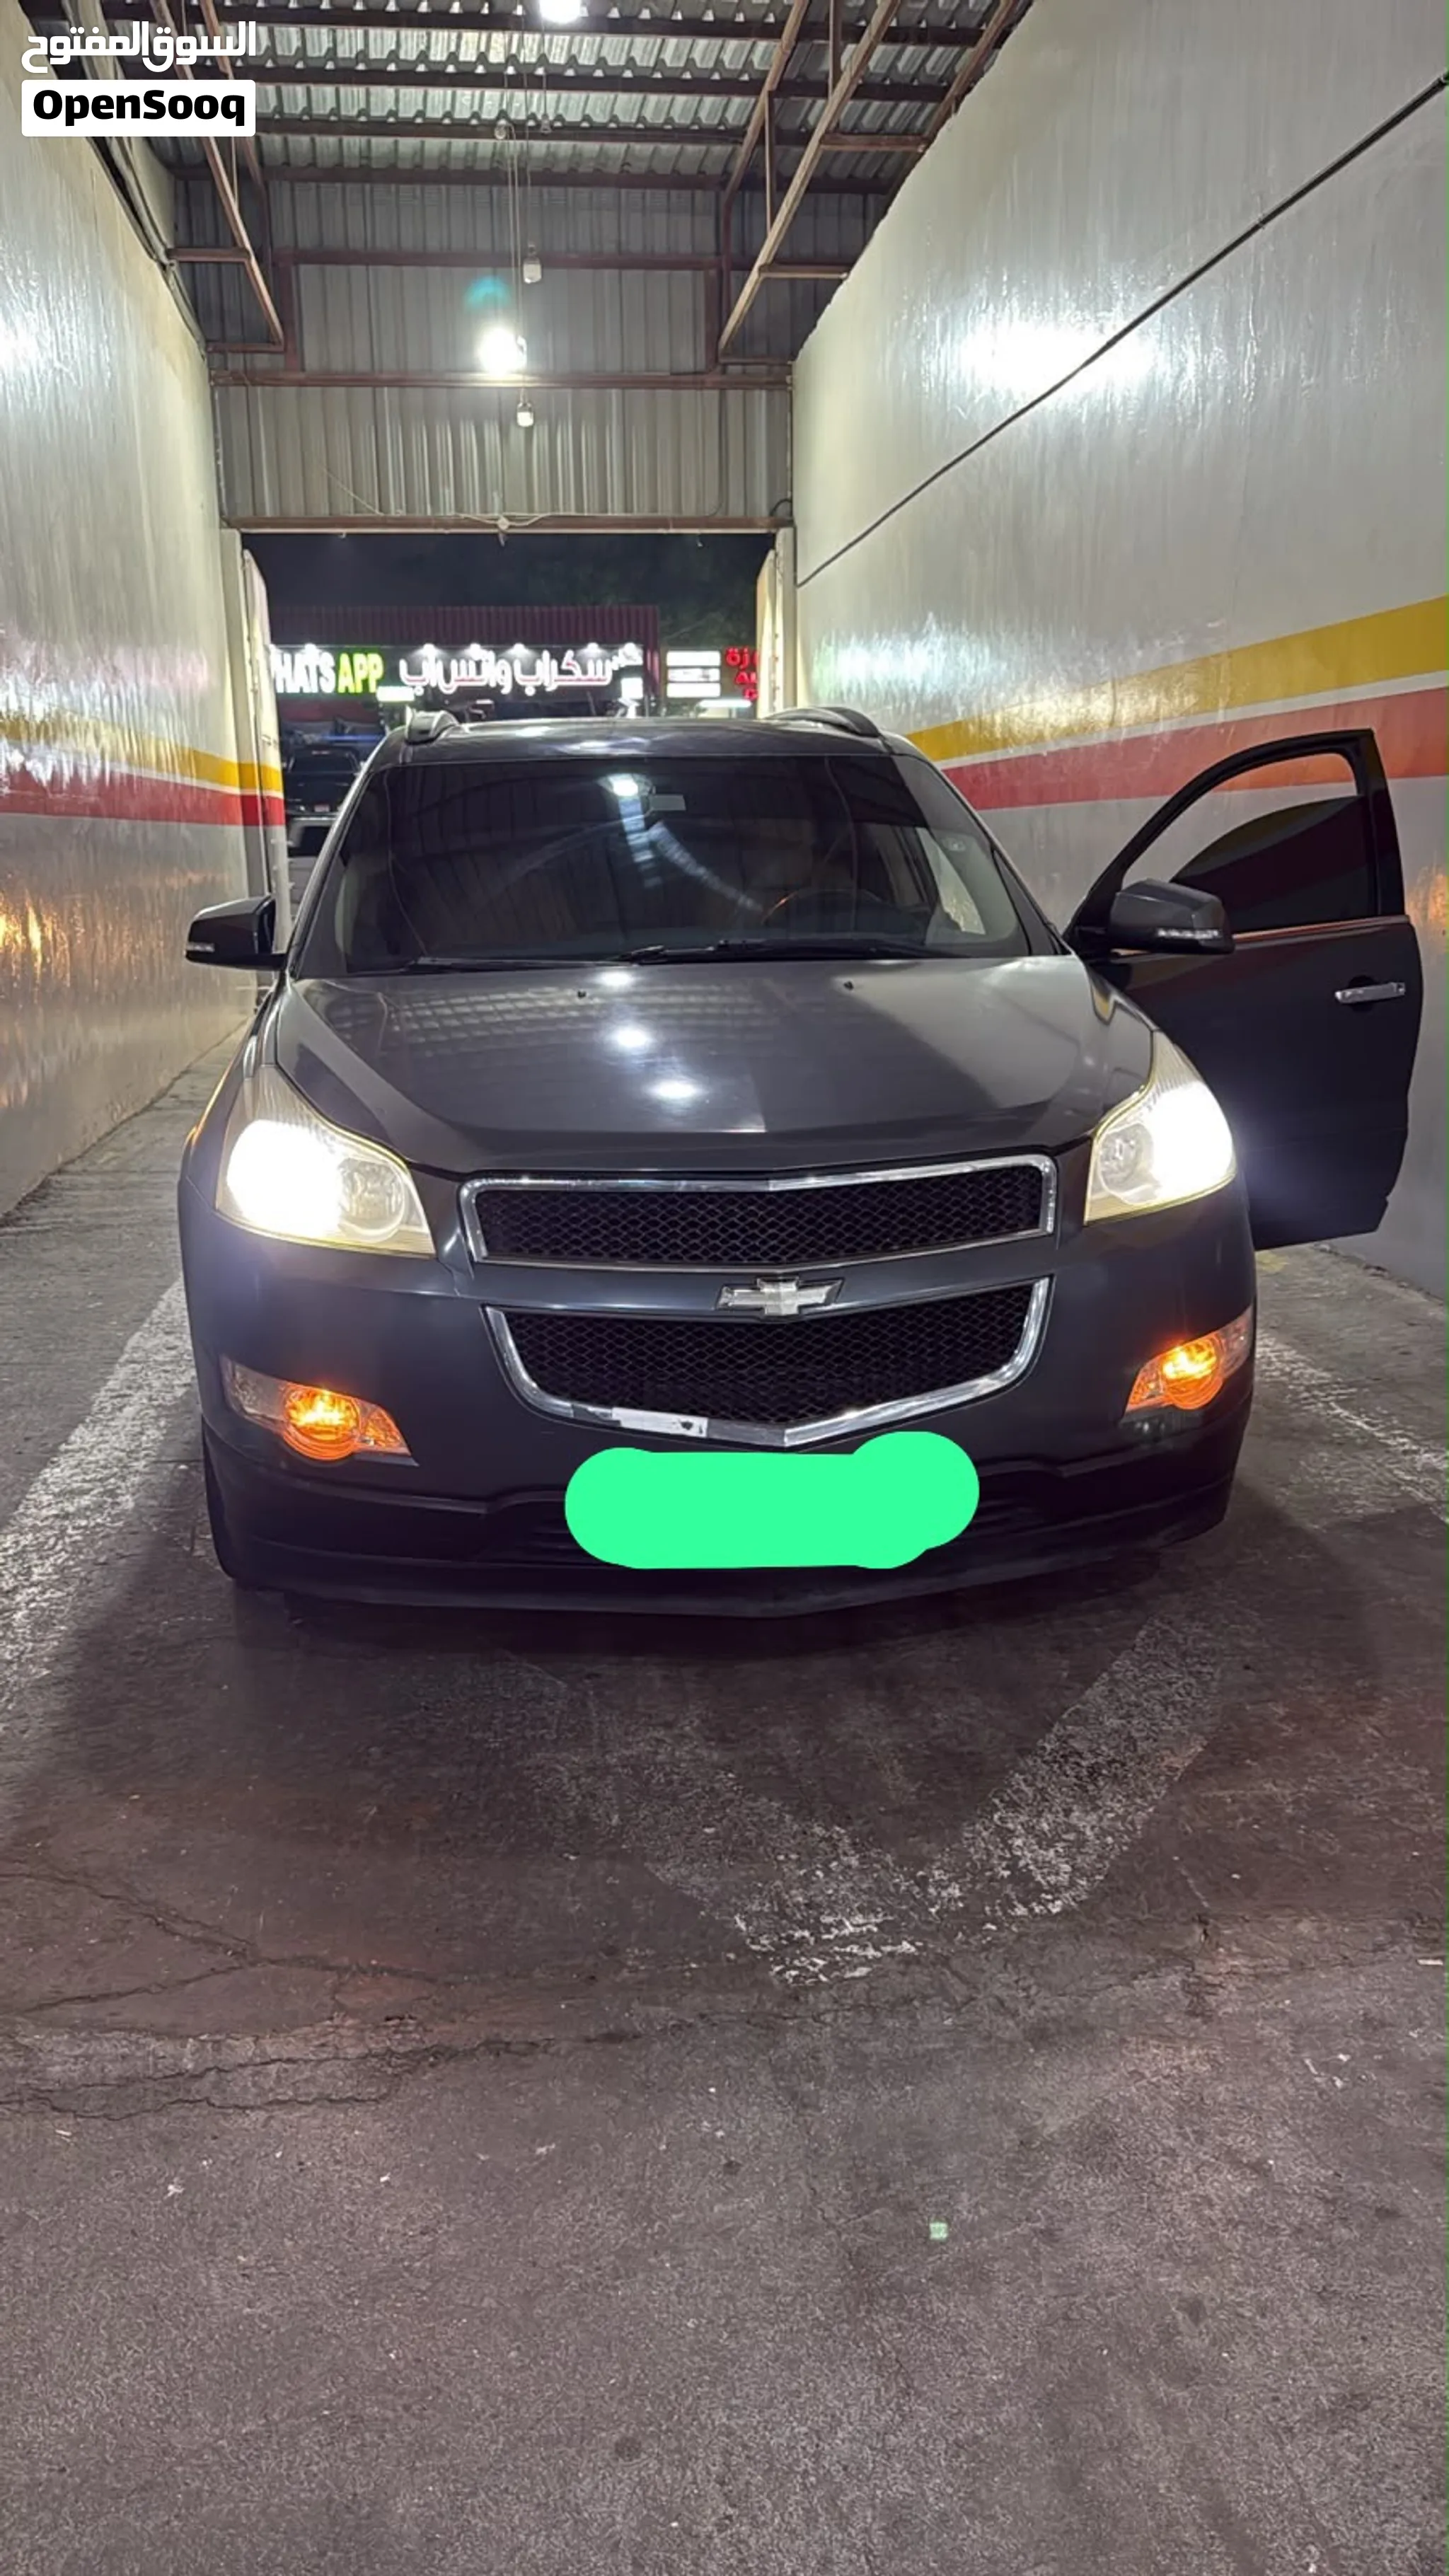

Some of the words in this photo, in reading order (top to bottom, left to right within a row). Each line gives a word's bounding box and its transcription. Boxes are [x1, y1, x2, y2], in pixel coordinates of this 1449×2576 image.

[270, 652, 335, 693] HATS
[337, 652, 383, 693] APP
[514, 649, 613, 696] سكراب
